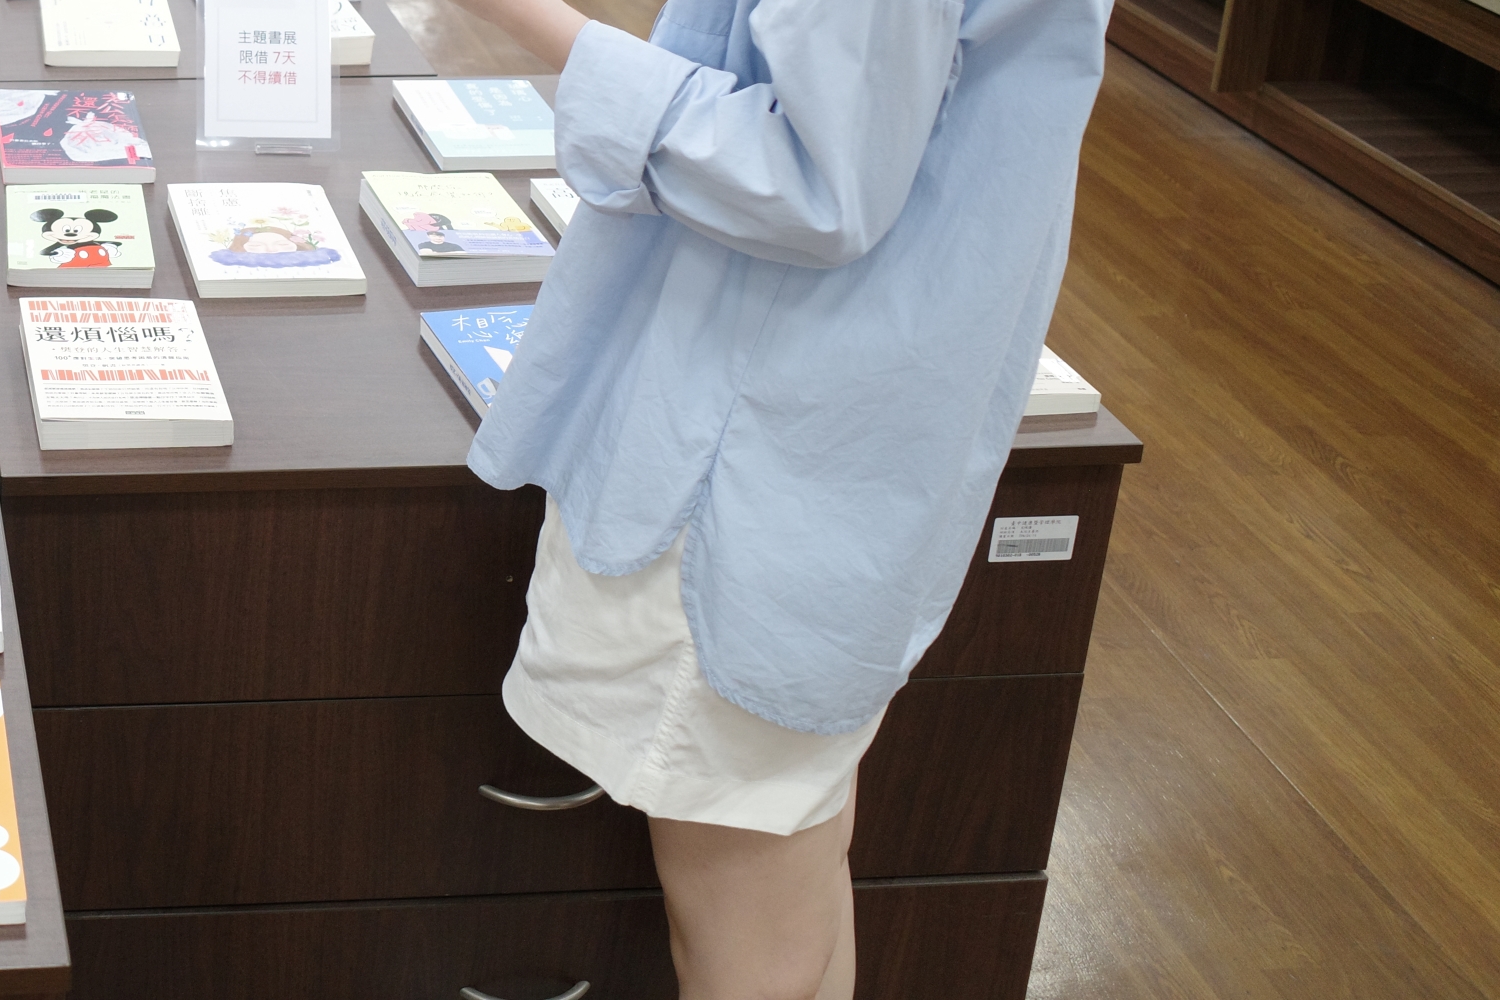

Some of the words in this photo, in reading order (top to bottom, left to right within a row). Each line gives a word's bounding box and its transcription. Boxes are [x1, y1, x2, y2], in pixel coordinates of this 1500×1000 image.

[238, 30, 297, 45] 主題書展
[239, 50, 268, 65] 限借
[273, 51, 296, 65] 7天
[238, 70, 297, 85] 不得續借
